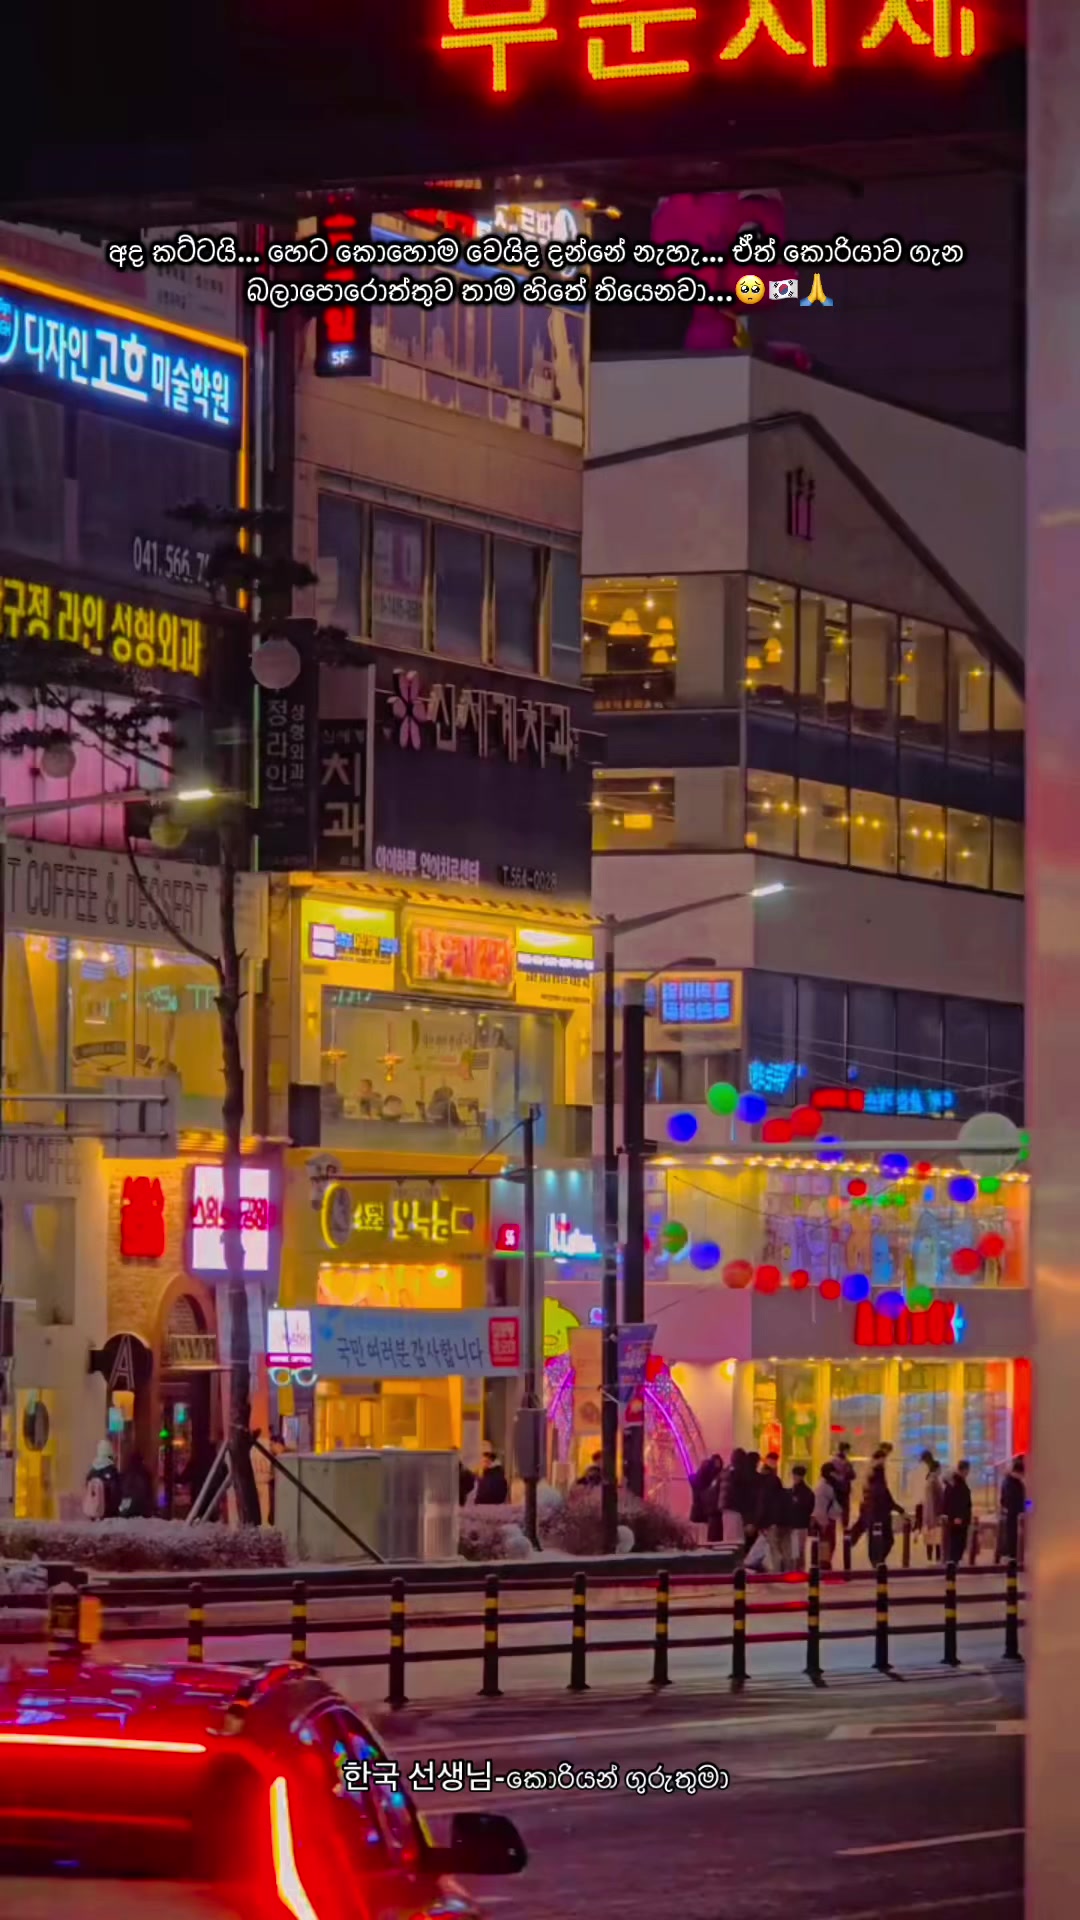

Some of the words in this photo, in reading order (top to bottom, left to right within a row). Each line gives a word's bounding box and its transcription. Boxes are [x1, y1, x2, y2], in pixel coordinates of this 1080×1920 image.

[24, 312, 88, 385] 디자인
[151, 352, 230, 424] 미술학원
[0, 575, 50, 641] 구정
[58, 590, 107, 656] 라인
[111, 602, 207, 677] 성형외과
[320, 752, 365, 848] 치과
[27, 860, 98, 923] COFFEE
[411, 1337, 483, 1369] 감사합니다
